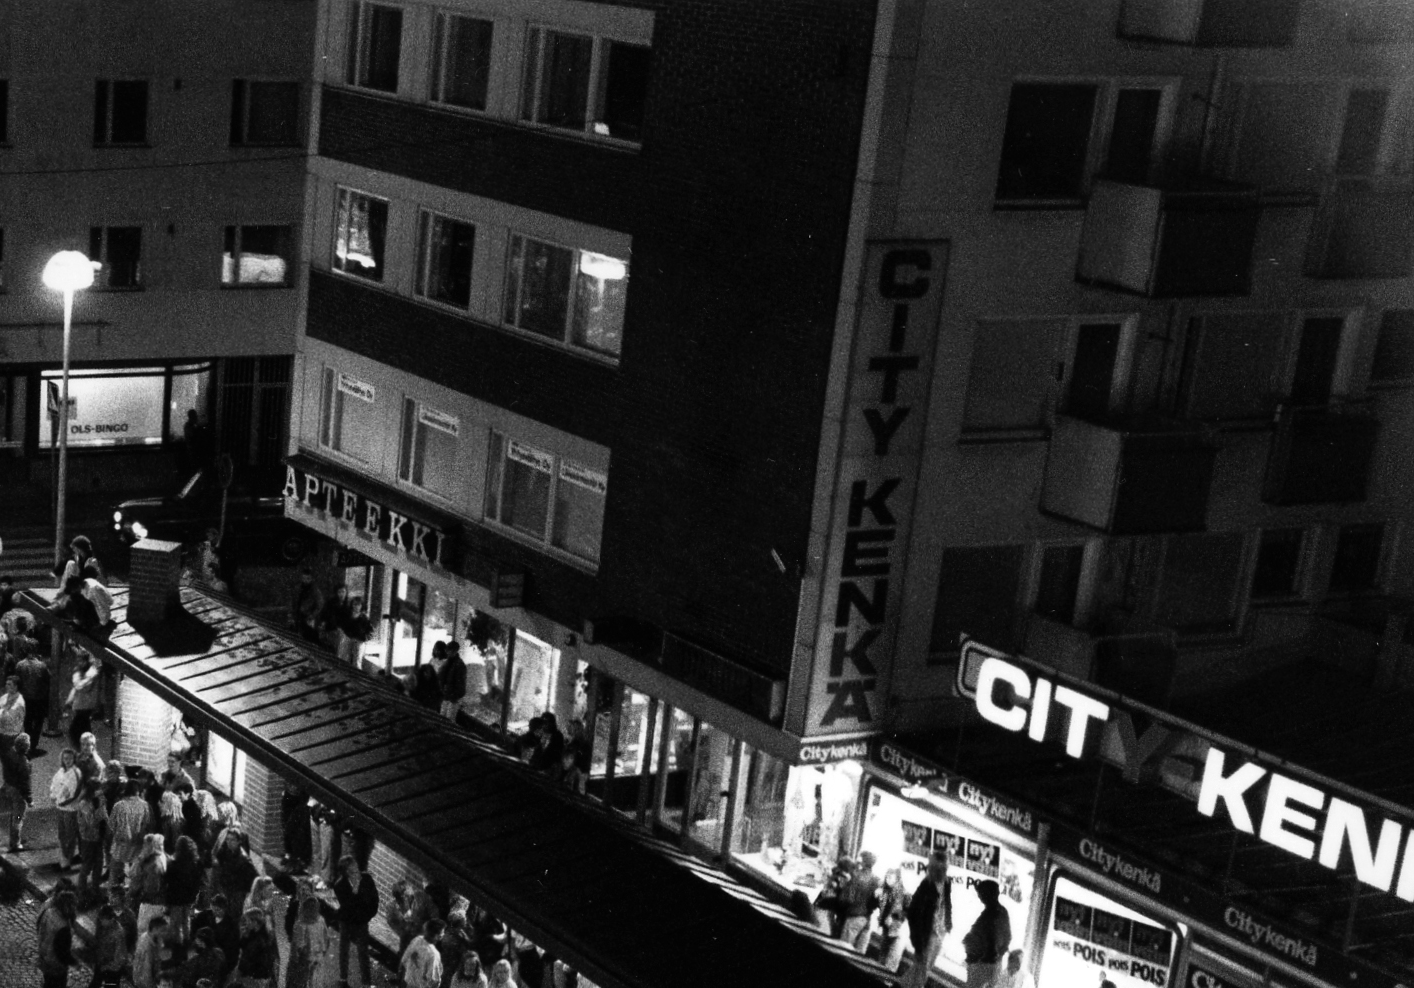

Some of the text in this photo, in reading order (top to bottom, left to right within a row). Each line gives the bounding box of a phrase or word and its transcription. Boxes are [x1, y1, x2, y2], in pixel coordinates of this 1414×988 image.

[863, 249, 932, 456] CITY
[71, 423, 129, 434] OLS-BINGO
[282, 464, 445, 568] APTEEKKI
[973, 656, 1170, 784] CITY
[1073, 942, 1106, 967] POIS
[1108, 958, 1129, 971] POIS
[1130, 961, 1166, 986] POIS
[1224, 907, 1317, 966] Citykenkä
